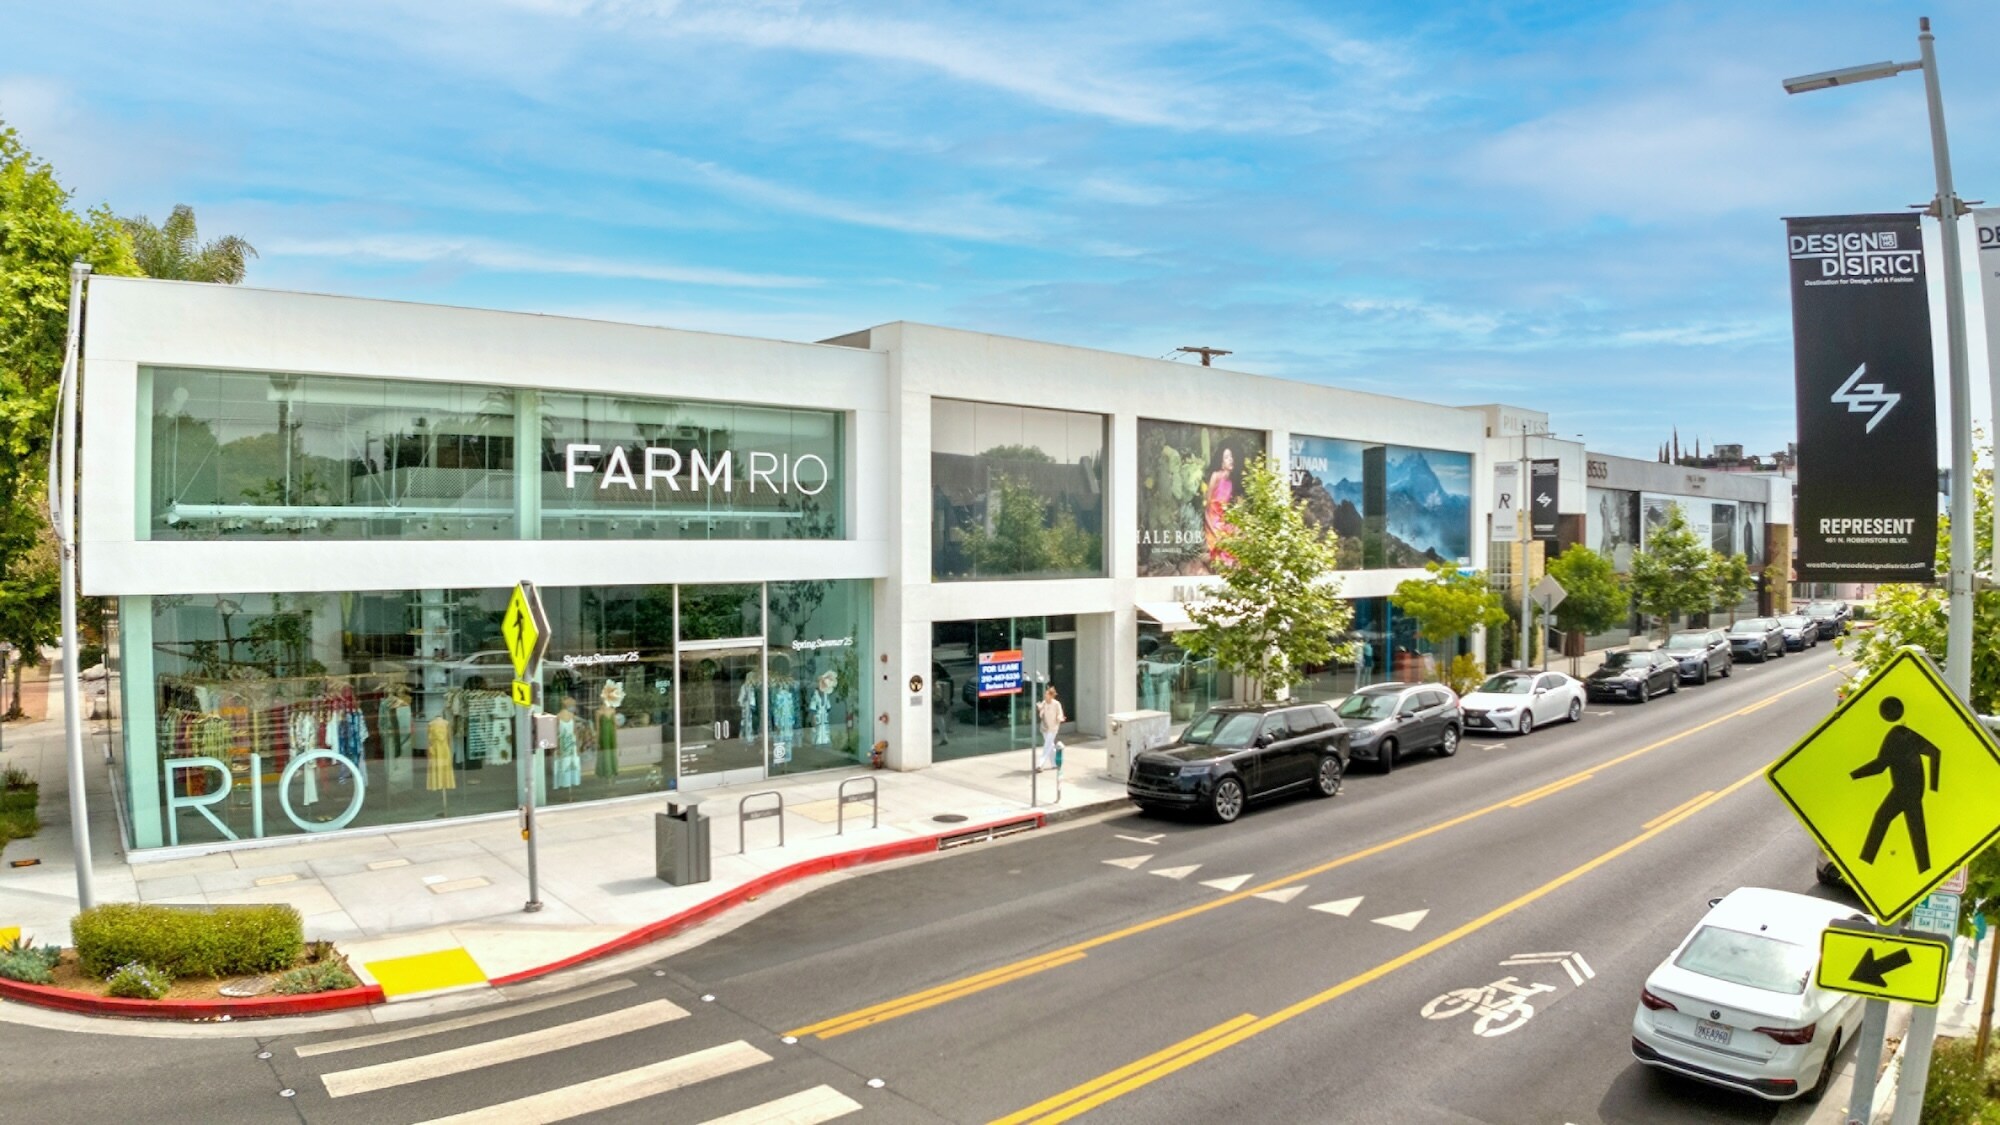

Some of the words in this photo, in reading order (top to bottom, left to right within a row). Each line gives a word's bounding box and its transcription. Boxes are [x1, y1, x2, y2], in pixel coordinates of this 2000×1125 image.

[1790, 232, 1878, 253] DESIGN
[1822, 253, 1919, 276] DISTRICT
[1805, 278, 1838, 286] Destination
[566, 444, 732, 492] FARM
[750, 452, 828, 495] RIO
[1820, 518, 1915, 534] REPRESENT
[1175, 530, 1204, 544] BOB
[1806, 562, 1925, 570] westhollywooddesigndistrict.com
[982, 665, 997, 673] FOR
[998, 663, 1019, 672] LEASE
[165, 749, 364, 846] RIO
